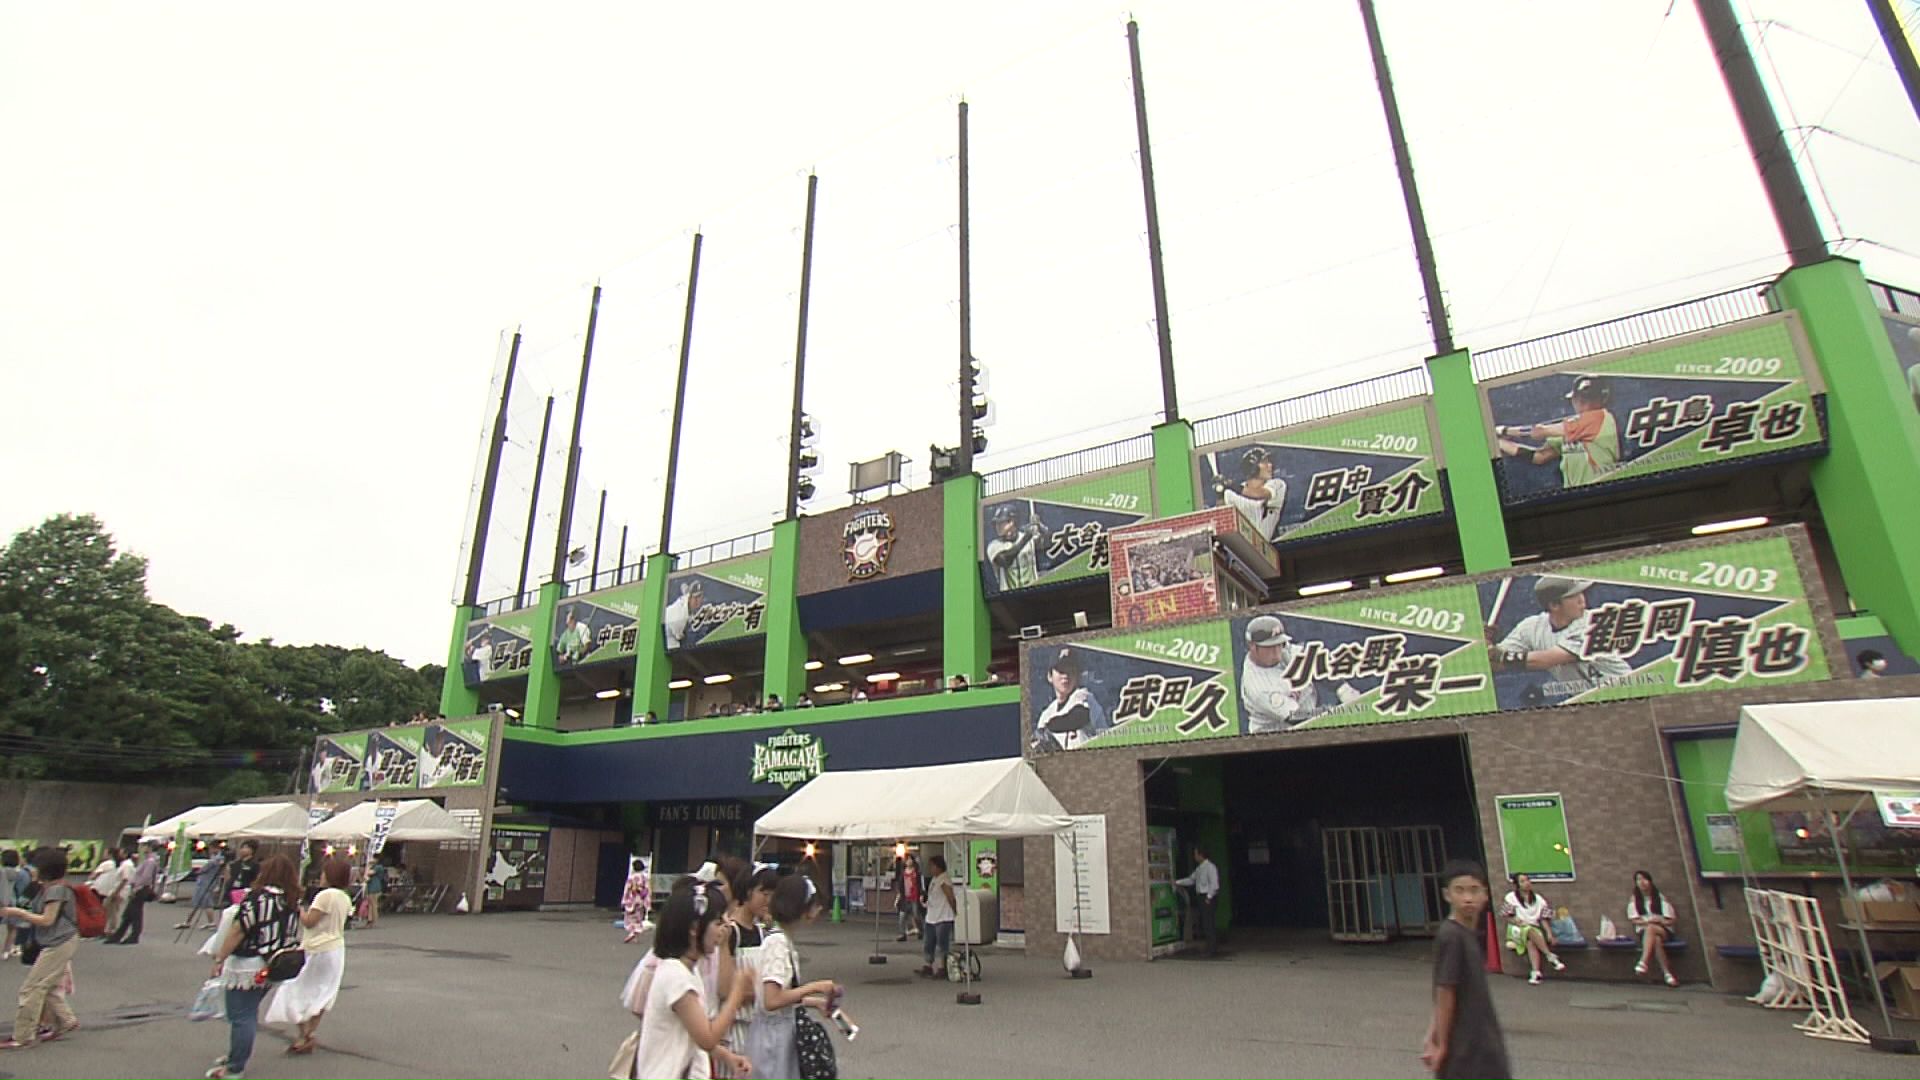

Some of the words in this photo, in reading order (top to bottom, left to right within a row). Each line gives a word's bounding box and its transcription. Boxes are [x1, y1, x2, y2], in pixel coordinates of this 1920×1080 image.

[1675, 362, 1713, 374] SINCE
[1714, 356, 1781, 377] 2009
[1626, 396, 1806, 454] 中島卓也
[1341, 437, 1369, 448] SINCE
[1371, 433, 1418, 452] 2000
[1105, 492, 1138, 510] 2013
[843, 512, 891, 538] FIGHTERS
[1639, 564, 1690, 583] SINCE
[1691, 561, 1778, 593] 2003
[1359, 606, 1397, 623] SINCE
[1399, 604, 1465, 633] 2003
[1135, 639, 1166, 654] SINCE
[1166, 637, 1220, 664] 2003
[1281, 632, 1487, 715] 小谷野栄一
[1112, 674, 1230, 735] 武田久
[767, 733, 811, 748] FIGHTERS
[753, 741, 821, 780] KAMAGAYA
[767, 769, 807, 783] STADIUM
[659, 804, 689, 821] FAN'S
[695, 804, 742, 822] LOUNGE
